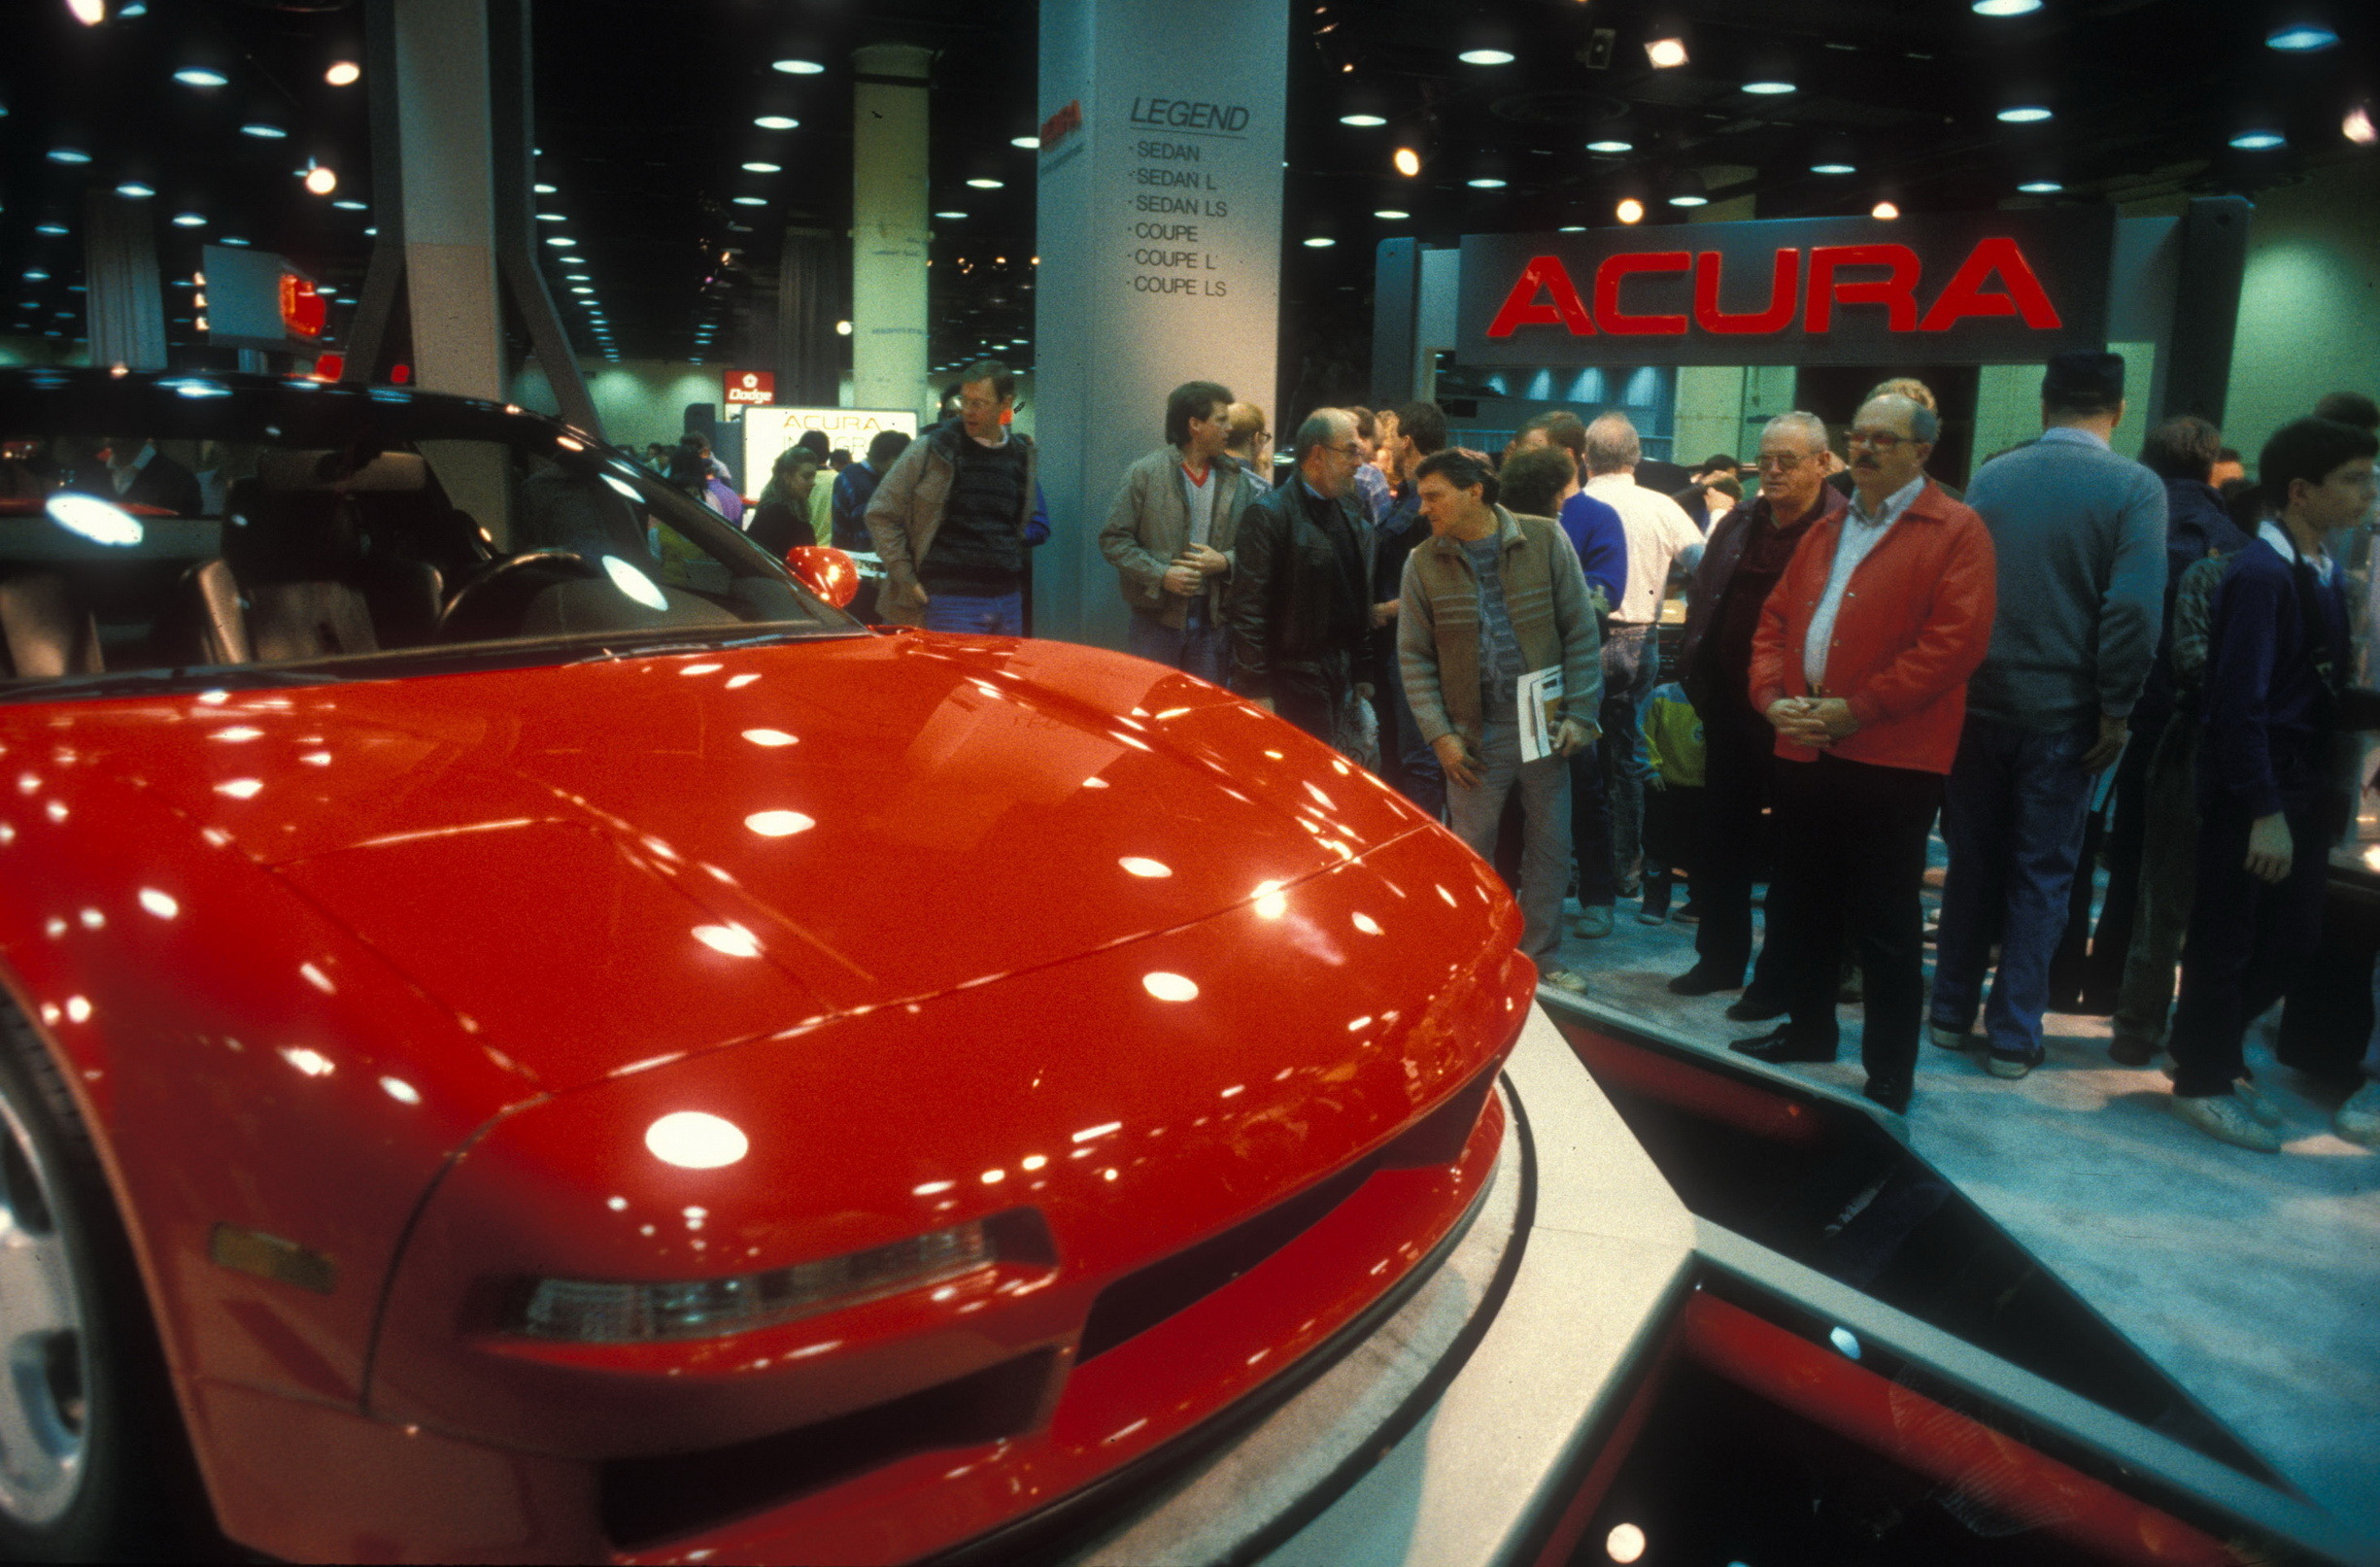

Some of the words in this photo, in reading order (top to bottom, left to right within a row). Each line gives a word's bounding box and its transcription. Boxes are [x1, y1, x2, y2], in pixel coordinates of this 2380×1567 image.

[1130, 96, 1250, 131] LEGEND
[1137, 141, 1200, 161] SEDAN
[1137, 168, 1199, 188] SEDAN
[1206, 173, 1217, 190] L
[1136, 194, 1199, 215] SEDAN
[1206, 200, 1228, 218] LS
[1136, 221, 1199, 242] COUPE
[1136, 249, 1198, 268] COUPE
[1206, 254, 1216, 270] L
[1134, 275, 1197, 295] COUPE
[1205, 280, 1227, 297] LS
[1486, 238, 2062, 337] ACURA
[729, 388, 772, 404] Dodge
[784, 415, 882, 431] ACURA
